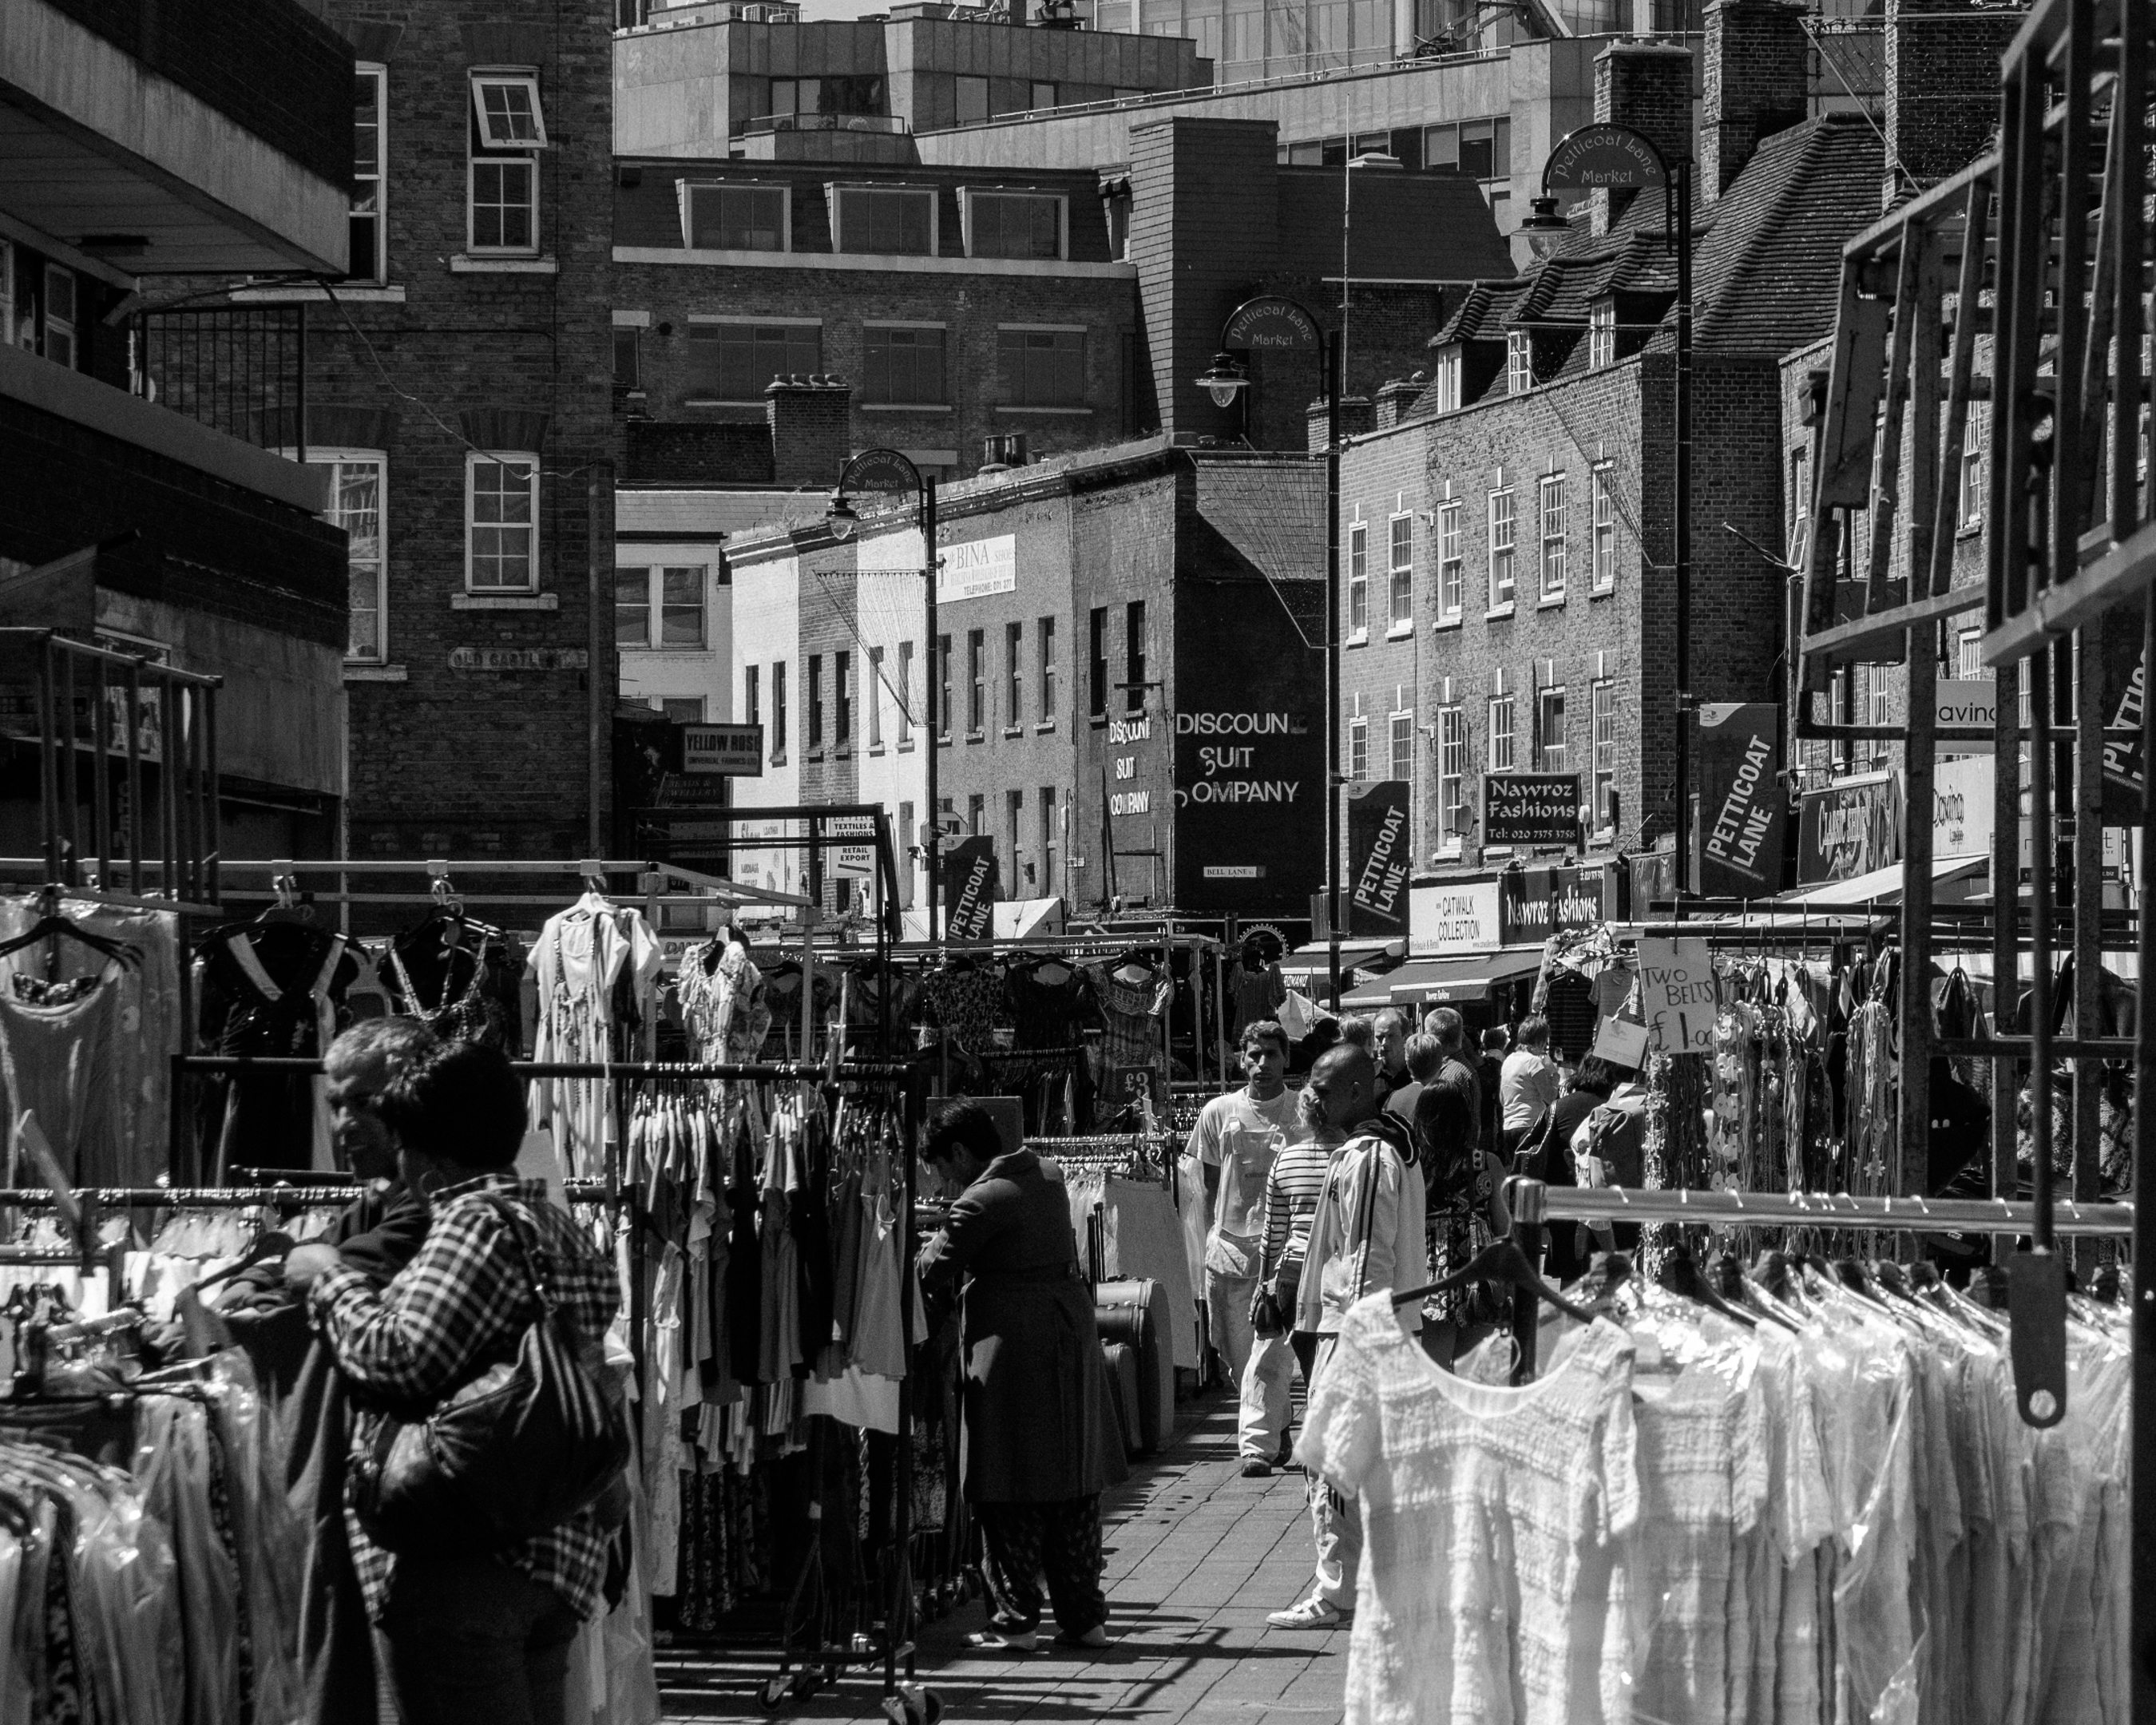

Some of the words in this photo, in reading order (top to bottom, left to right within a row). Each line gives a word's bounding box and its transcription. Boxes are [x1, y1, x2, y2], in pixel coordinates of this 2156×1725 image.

[1554, 134, 1621, 180] Petticoat
[1624, 137, 1656, 176] Lane
[1581, 169, 1632, 184] Market
[1231, 306, 1285, 341] Petticoat
[1287, 309, 1312, 341] Lane
[1251, 334, 1293, 346] Market
[847, 456, 891, 486] Petticoat
[893, 458, 914, 483] Lane
[864, 479, 898, 489] Market
[955, 543, 989, 570] BINA
[687, 734, 727, 751] YELLOW
[1116, 756, 1135, 780] SUIT
[1199, 746, 1254, 776] SUIT
[1489, 779, 1573, 797] Nawroz
[1706, 735, 1771, 858] PETTICOAT
[1488, 798, 1575, 818] Fashions
[1488, 827, 1508, 839] Tel:
[1512, 830, 1531, 839] 020
[1533, 830, 1553, 839] 7375
[1556, 830, 1575, 839] 3758
[1732, 805, 1773, 867] LANE
[1354, 805, 1405, 905] PETTICOAT
[948, 855, 991, 940] PETTICOAT
[1374, 862, 1407, 912] LANE
[1442, 895, 1475, 917] CATWALK
[1506, 893, 1549, 926] Nawroz
[1551, 884, 1597, 923] Fashions
[965, 901, 992, 941] LANE
[1437, 919, 1480, 941] COLLECTION
[1641, 966, 1688, 988] TWO
[1666, 980, 1714, 1006] BELTS
